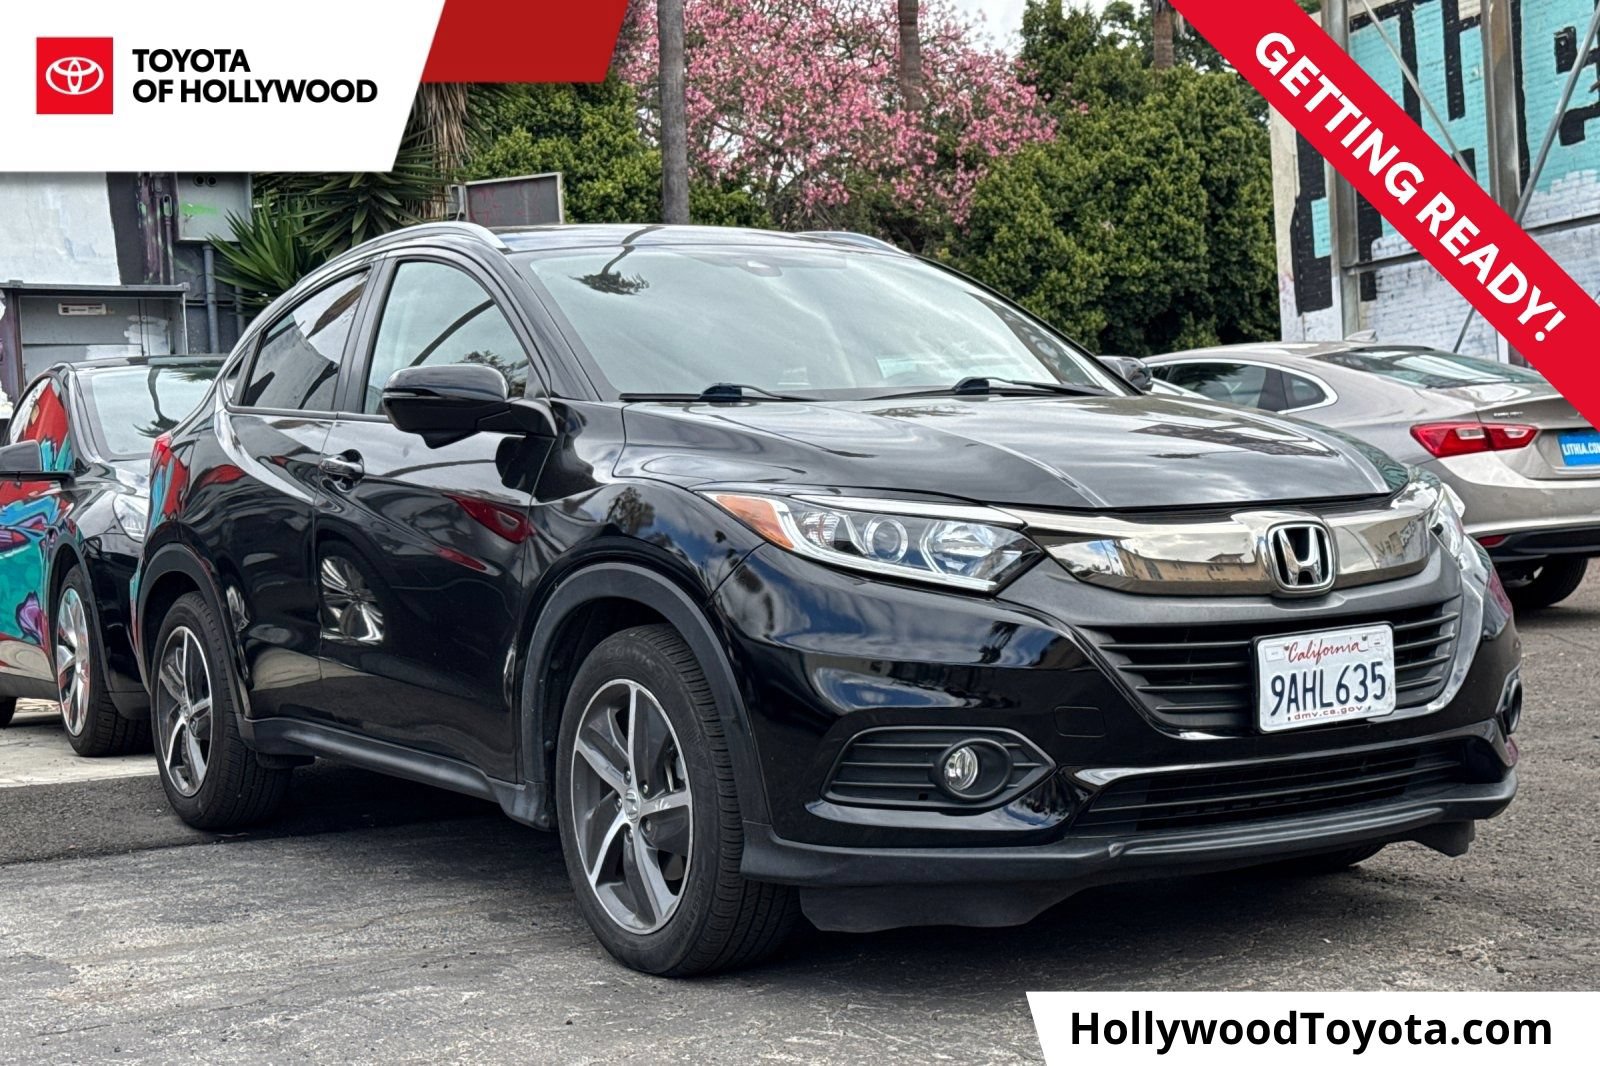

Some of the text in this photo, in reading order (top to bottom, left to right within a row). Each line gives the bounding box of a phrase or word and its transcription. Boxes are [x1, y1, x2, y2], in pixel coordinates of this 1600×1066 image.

[1287, 637, 1369, 665] California
[1270, 661, 1387, 717] 9AHL635
[1293, 704, 1364, 721] dmv.ca.gov
